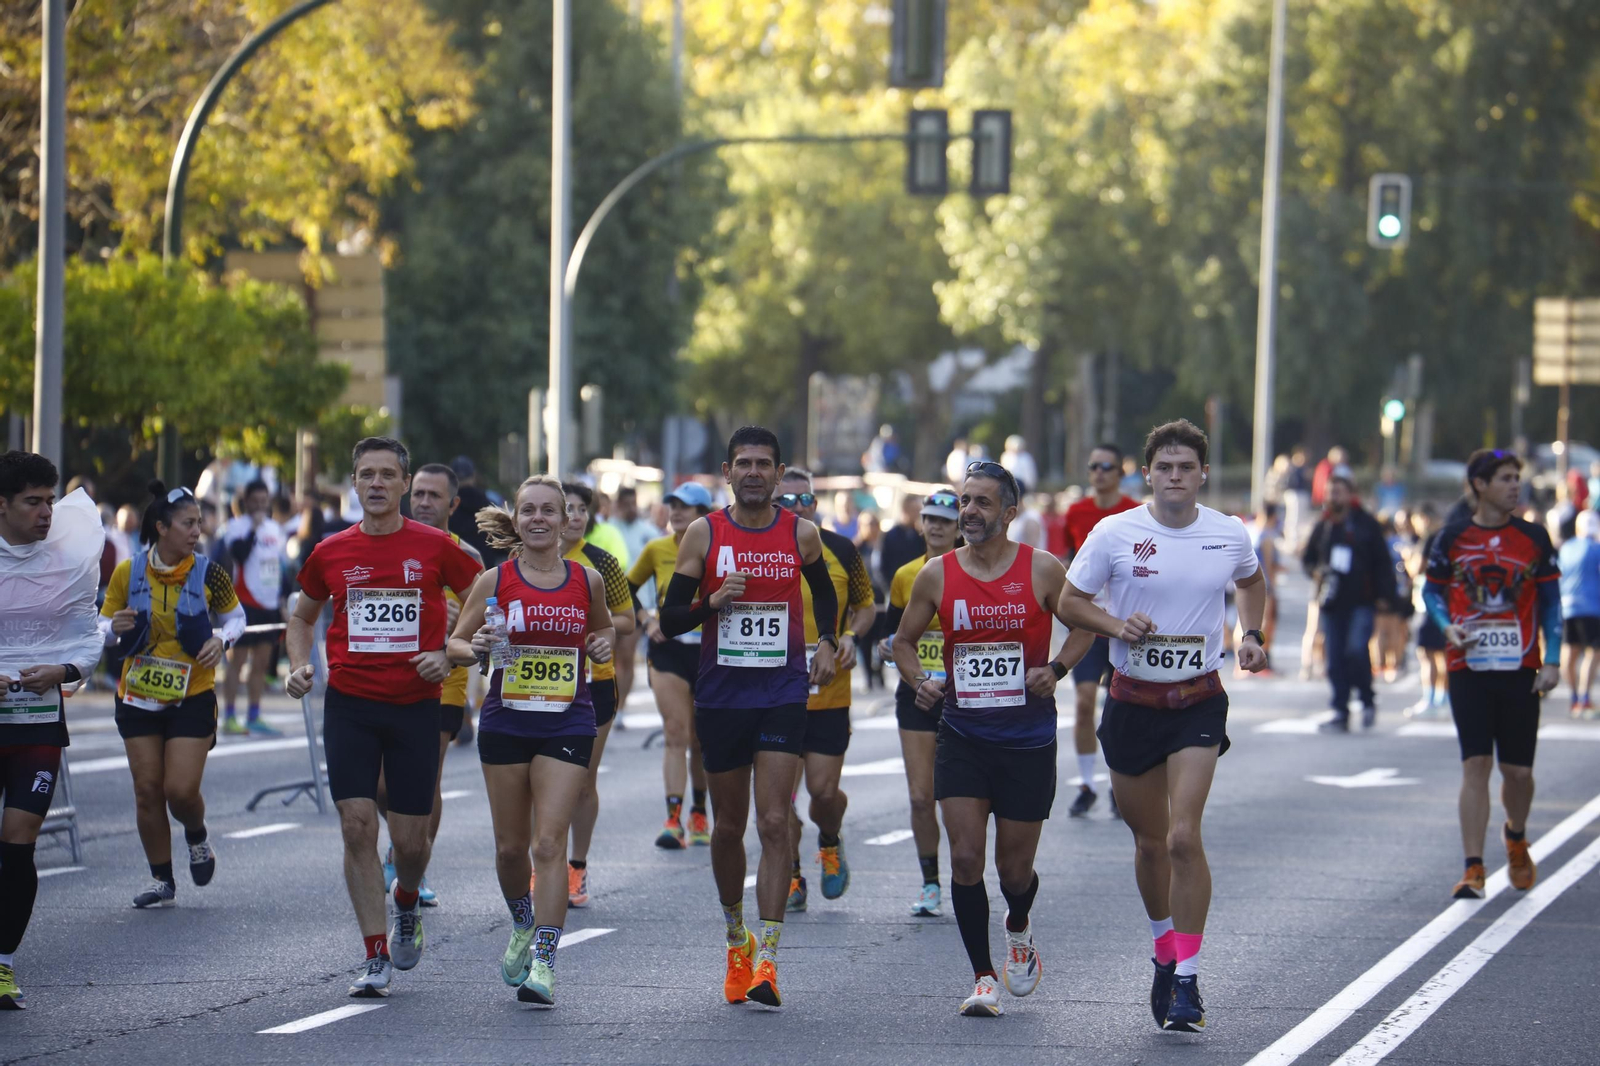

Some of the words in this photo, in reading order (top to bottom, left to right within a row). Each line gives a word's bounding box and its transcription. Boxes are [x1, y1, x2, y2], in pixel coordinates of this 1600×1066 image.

[350, 590, 364, 600] 38
[364, 603, 417, 622] 3266
[756, 604, 786, 612] MARATÓN
[740, 617, 780, 637] 815
[1171, 636, 1203, 644] MARATÓN
[1479, 632, 1519, 647] 2038
[955, 646, 967, 657] 38
[1146, 648, 1203, 669] 6674
[520, 661, 574, 682] 5983
[969, 657, 1021, 678] 3267
[140, 669, 185, 691] 4593
